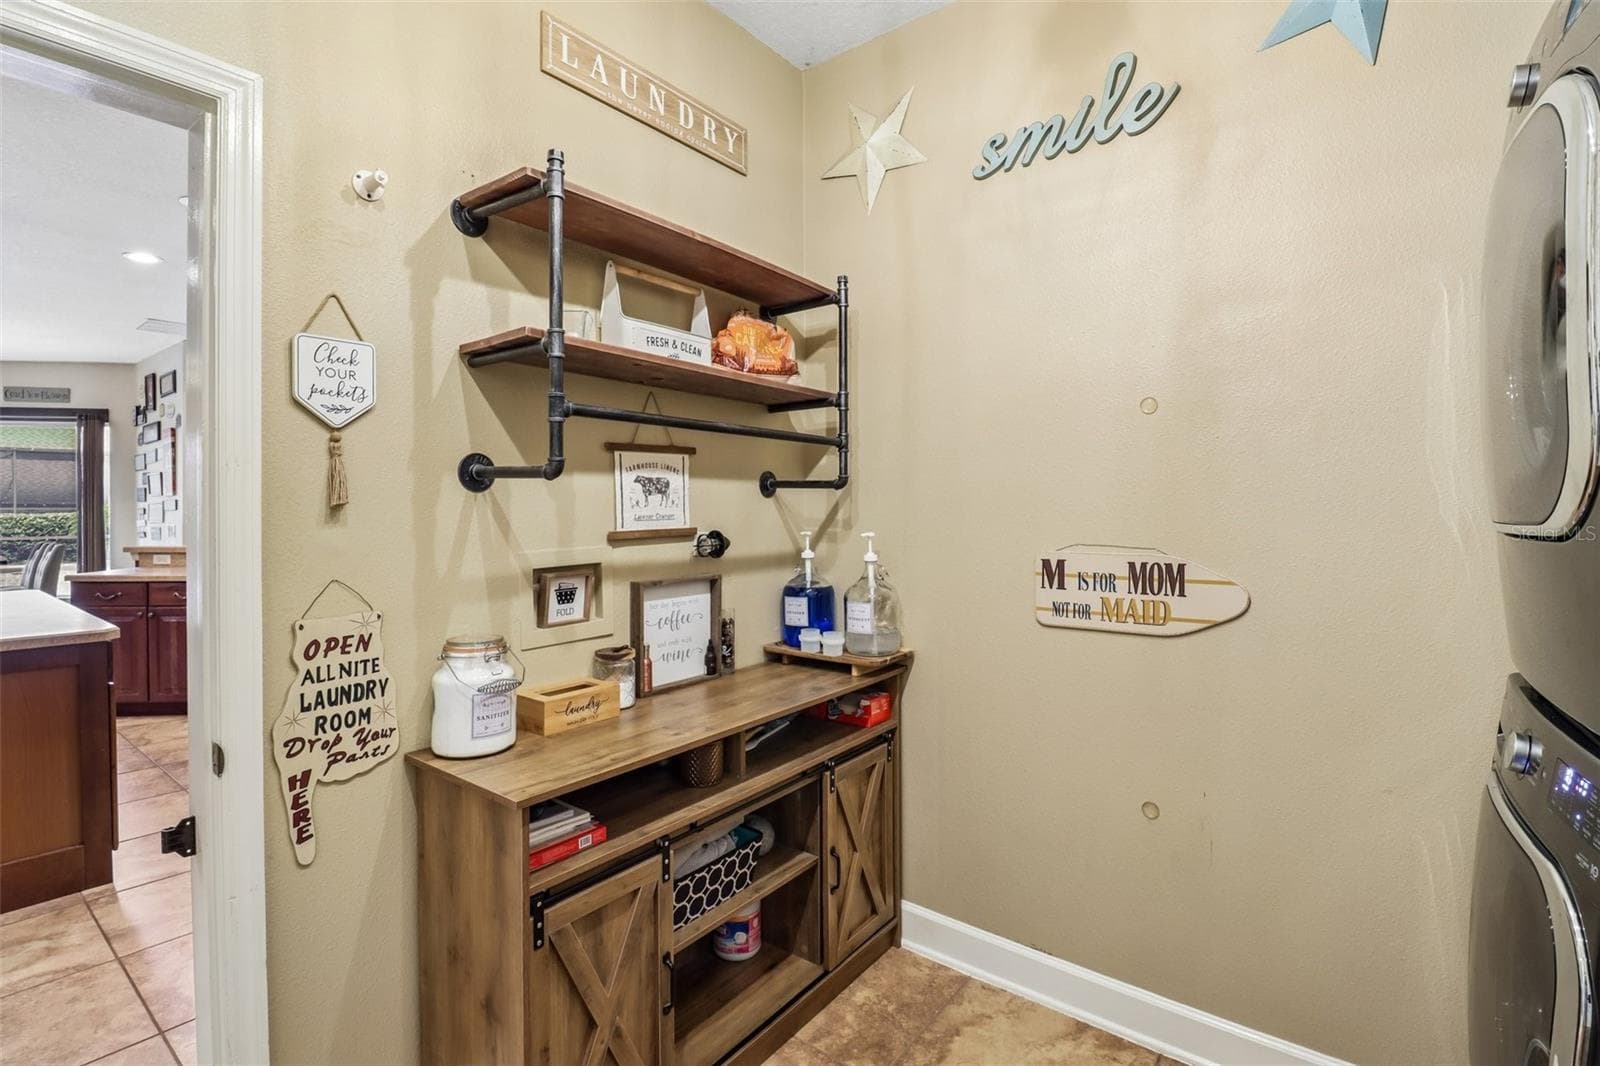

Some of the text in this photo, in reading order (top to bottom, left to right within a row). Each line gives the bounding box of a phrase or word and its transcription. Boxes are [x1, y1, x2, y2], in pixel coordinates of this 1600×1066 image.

[559, 32, 738, 154] LAUNDRY
[972, 51, 1182, 181] smile
[313, 342, 360, 367] Check
[646, 335, 702, 358] FRESH & CLEAN
[316, 366, 357, 381] YOUR
[307, 380, 369, 403] pockets
[1040, 558, 1187, 598] M IS FOR MOM
[556, 607, 575, 617] FOLD
[646, 609, 703, 632] coffee
[1051, 596, 1172, 626] NOT FOR MAID
[303, 632, 373, 661] OPEN
[655, 648, 702, 663] wine
[300, 657, 381, 687] ALL NITE
[299, 677, 390, 713] LAUNDRY
[555, 696, 609, 716] laundry
[314, 706, 371, 736] ROOM
[283, 726, 397, 760] Drop Your
[323, 744, 391, 777] Pants
[288, 768, 314, 845] HERE
